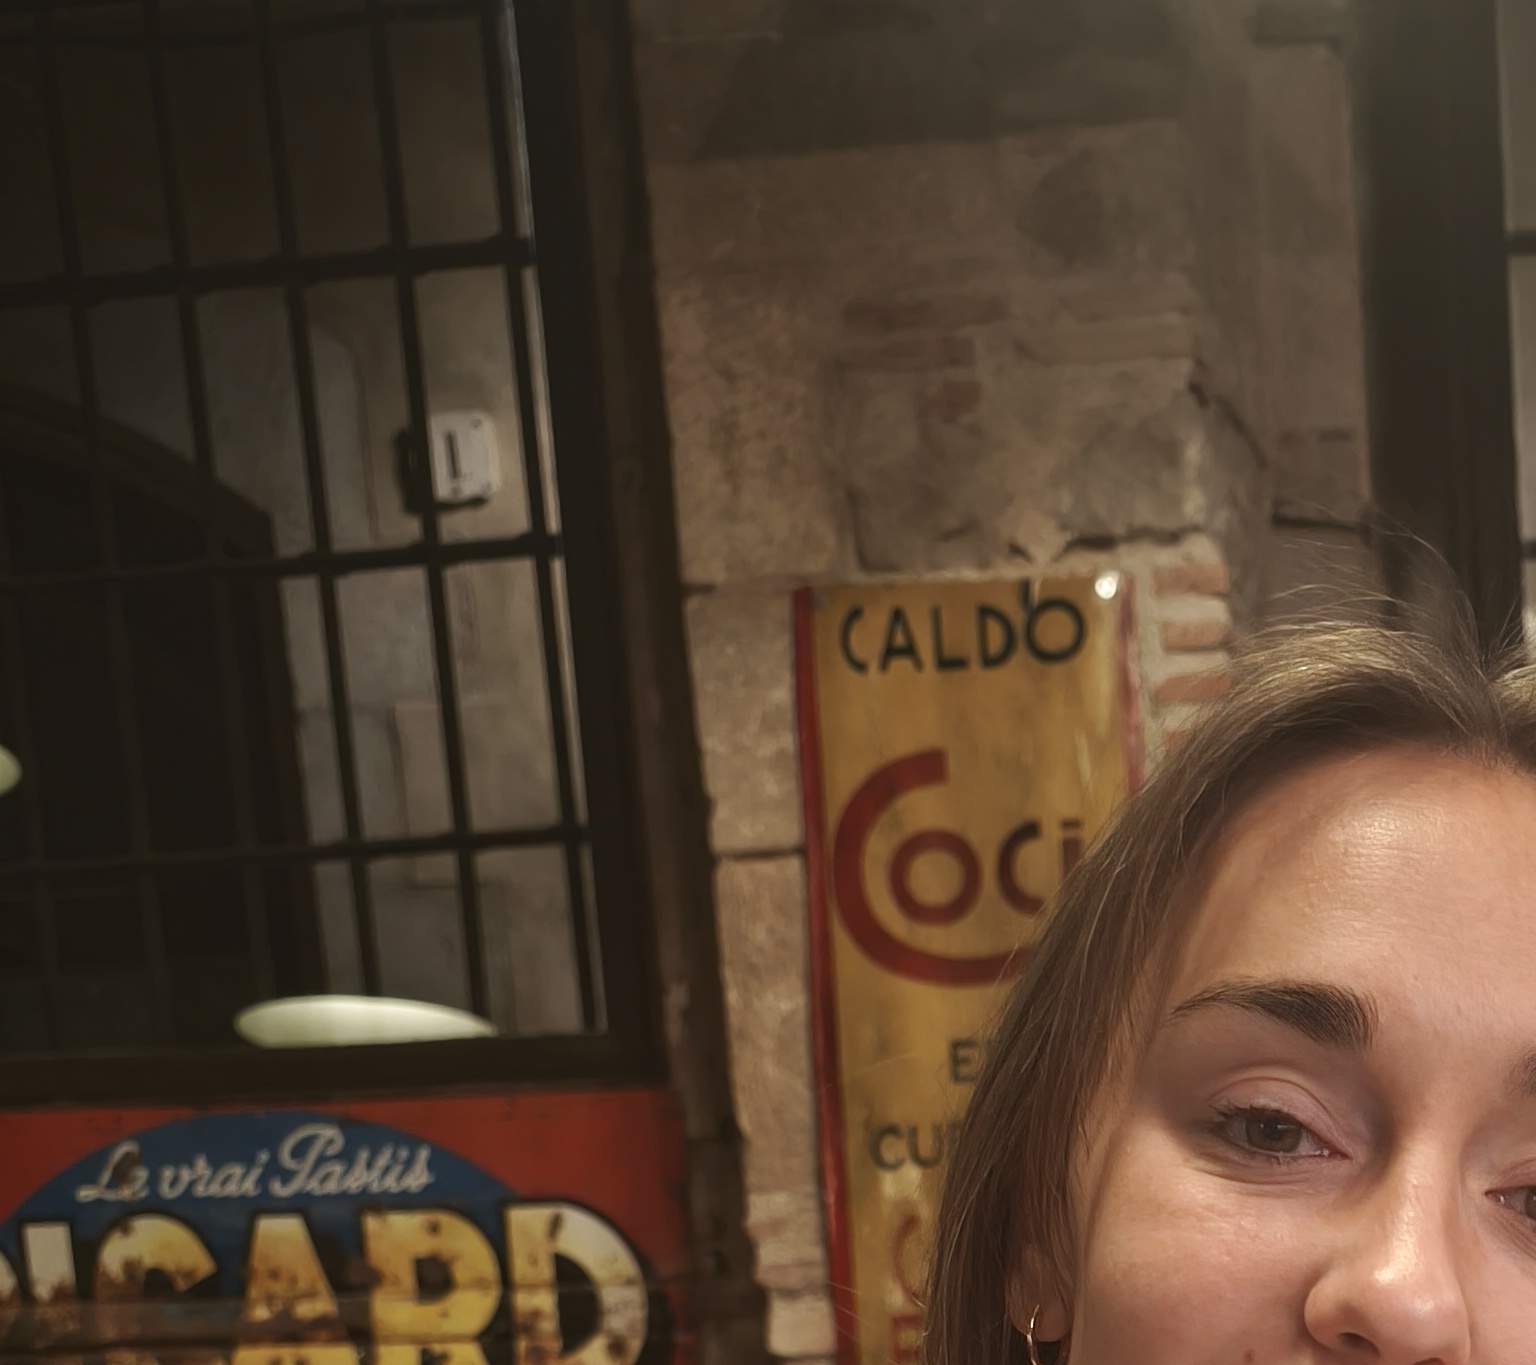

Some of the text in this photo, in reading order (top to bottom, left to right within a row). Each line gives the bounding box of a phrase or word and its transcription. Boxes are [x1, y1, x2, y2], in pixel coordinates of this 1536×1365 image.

[838, 594, 1087, 676] CALDO
[76, 1122, 435, 1203] Le vrai Pastis
